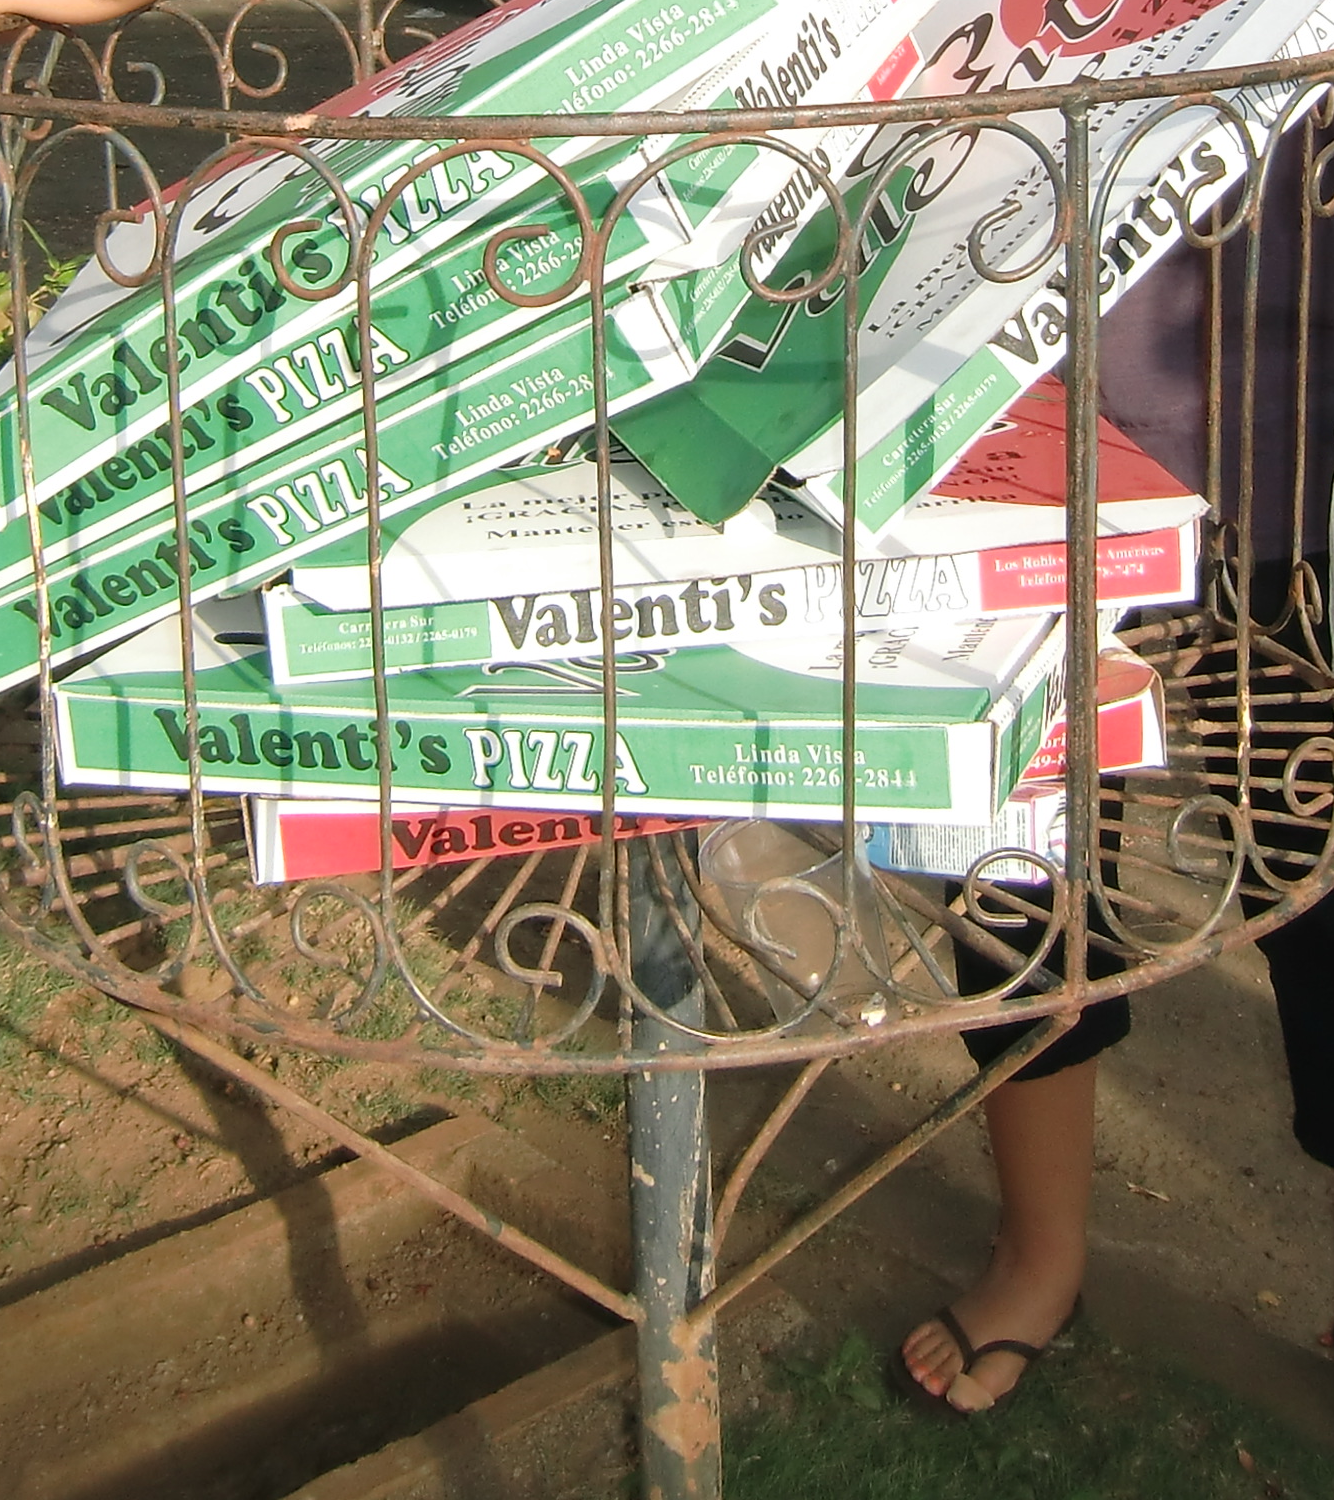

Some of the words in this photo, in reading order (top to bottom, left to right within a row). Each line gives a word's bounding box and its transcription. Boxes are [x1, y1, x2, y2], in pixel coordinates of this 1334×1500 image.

[565, 41, 630, 88] Linda
[625, 0, 685, 41] Vista
[450, 258, 509, 294] Lina
[506, 231, 561, 263] Vista
[428, 281, 518, 332] Teléfon:
[244, 314, 410, 426] PIZZA
[454, 392, 514, 428] Linda
[511, 366, 565, 394] Vista
[430, 413, 522, 462] Teléfono:
[518, 369, 616, 420] 2266-284
[881, 412, 937, 467] Carretera
[933, 392, 957, 416] Sur
[13, 517, 256, 638] Valenti's
[245, 446, 414, 548] PIZZA
[487, 521, 651, 541] Manteer
[994, 558, 1019, 572] Los
[1019, 571, 1065, 587] Teléfon
[338, 614, 407, 635] Carrera
[410, 614, 434, 628] Sur
[358, 633, 413, 649] 22-0132
[489, 574, 787, 651] Valenti's
[153, 708, 452, 775] Valenti's
[463, 727, 650, 795] PIZZA
[689, 764, 795, 785] Teléfono:
[802, 766, 917, 788] 226-2844
[735, 743, 801, 764] Linda
[807, 744, 866, 765] Visa
